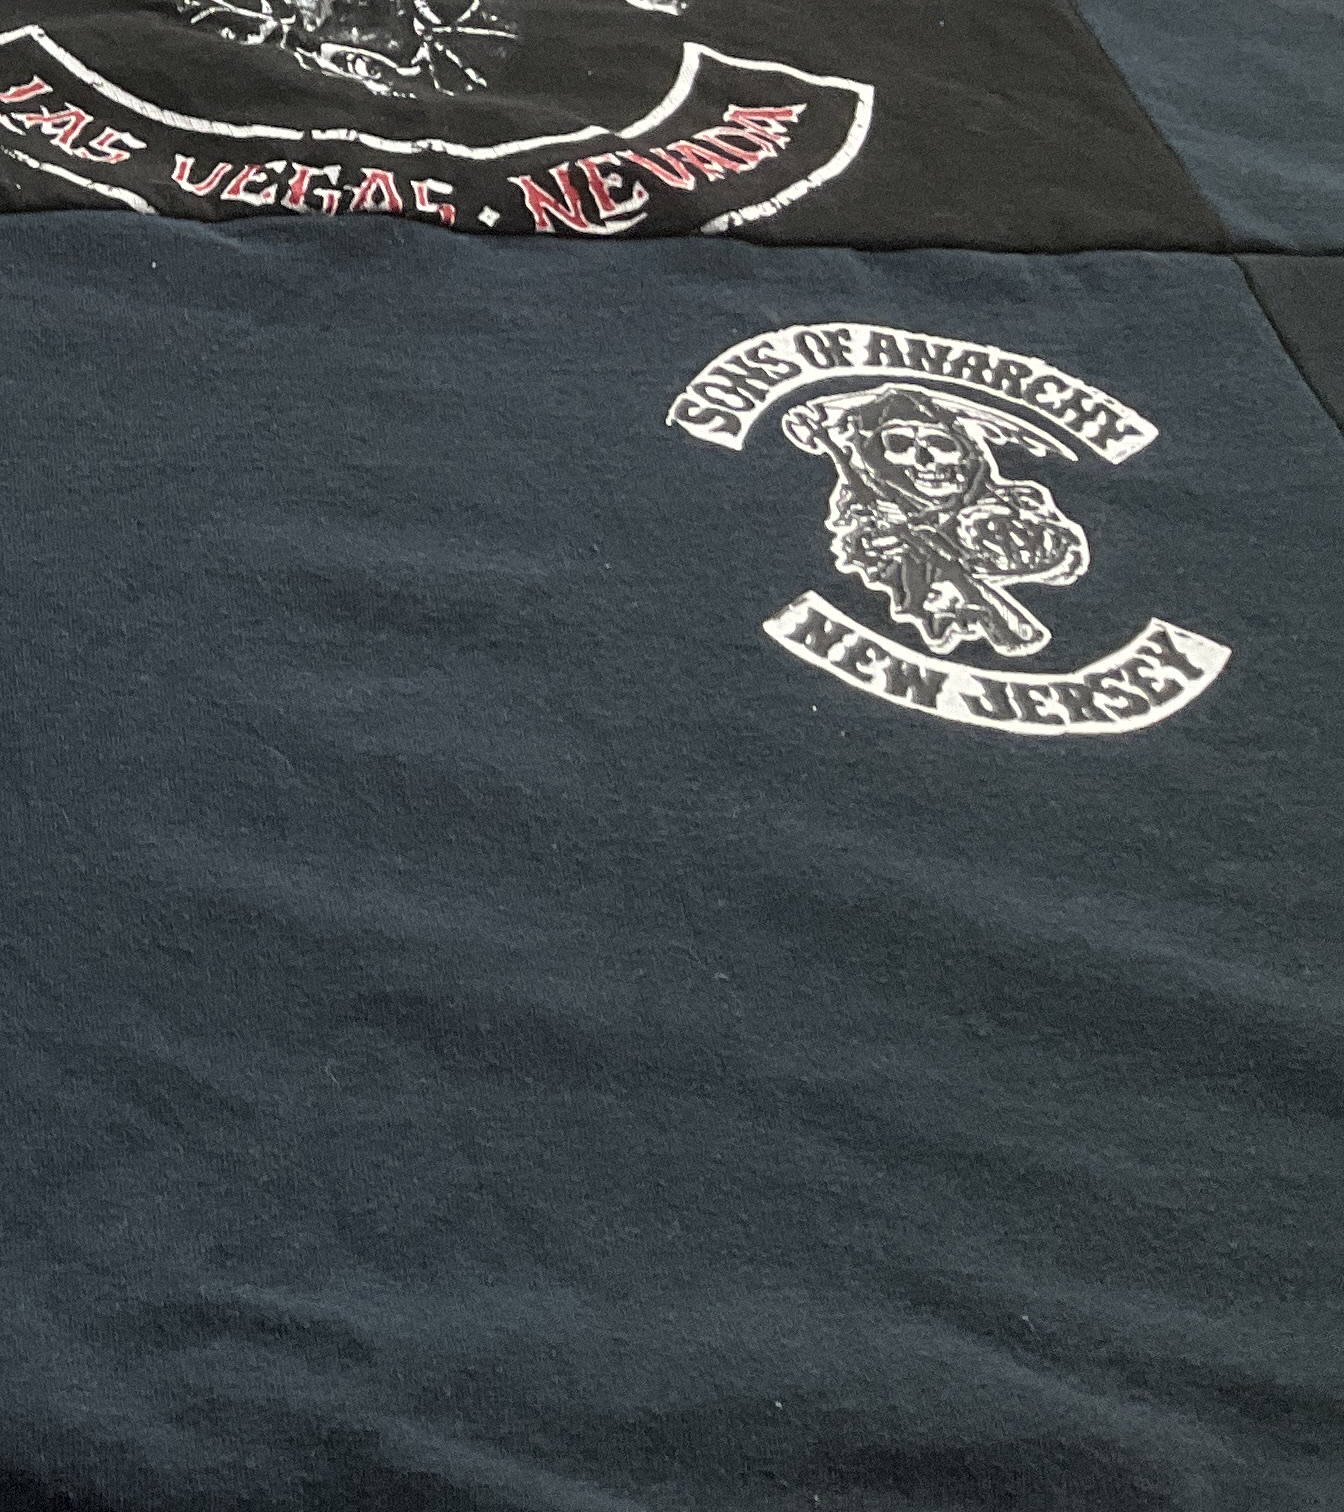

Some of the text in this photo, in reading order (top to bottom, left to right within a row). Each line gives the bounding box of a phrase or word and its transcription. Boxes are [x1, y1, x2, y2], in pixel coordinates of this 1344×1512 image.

[172, 148, 460, 226] VEGAS
[513, 102, 808, 236] NEVADA
[672, 327, 1144, 449] SONS OF ANARCHY
[788, 607, 1205, 726] NEW JERSEY
